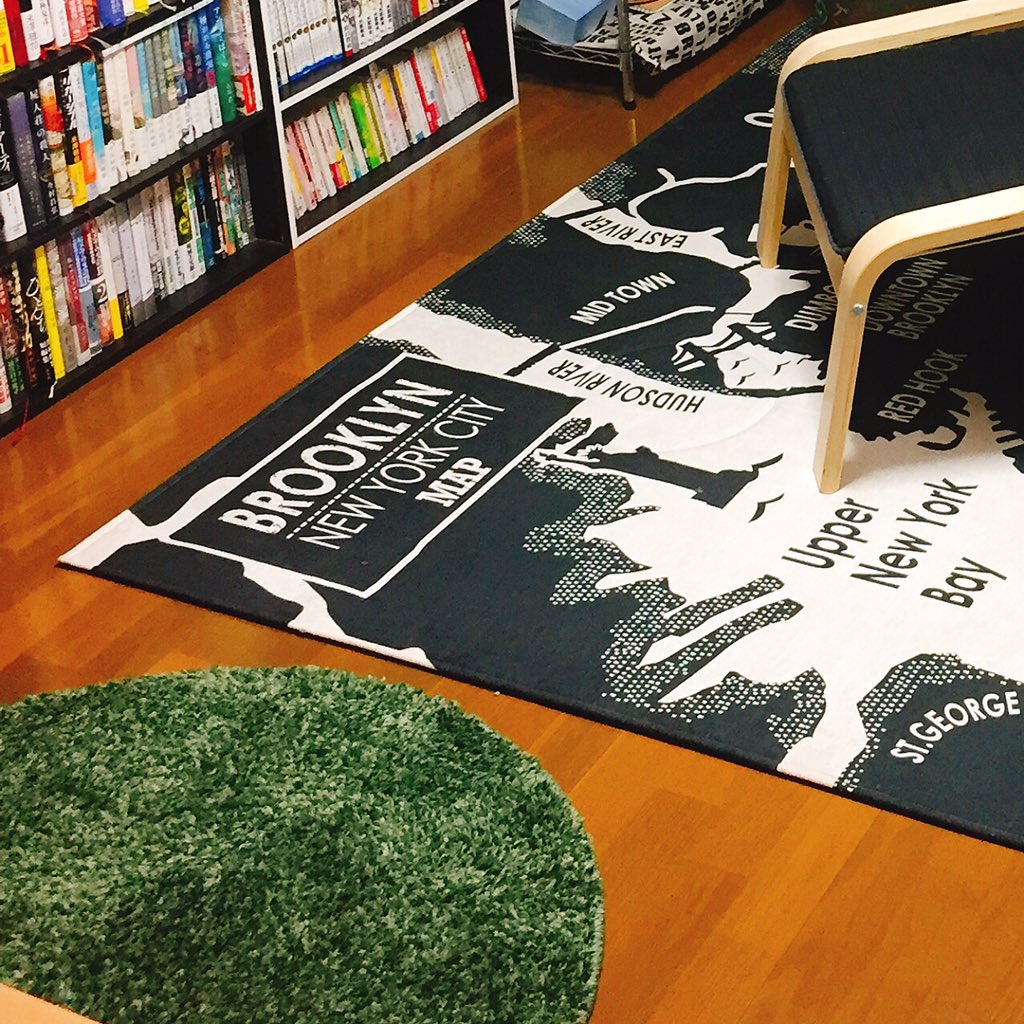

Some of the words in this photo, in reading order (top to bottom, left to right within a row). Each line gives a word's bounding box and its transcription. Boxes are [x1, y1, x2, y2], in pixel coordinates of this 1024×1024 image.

[584, 216, 638, 242] RIVER
[639, 226, 687, 248] EAST
[569, 300, 617, 326] MID
[604, 271, 676, 304] TOWN
[887, 273, 973, 340] BROOKLYN
[547, 358, 607, 390] RIVER
[601, 375, 705, 414] HUDSON
[877, 394, 927, 423] RED
[904, 348, 968, 394] HOOK
[219, 377, 454, 535] BROOKLYN
[298, 494, 386, 550] NEW
[360, 438, 459, 494] YORK
[433, 396, 506, 441] CITY
[415, 456, 494, 507] MAP
[782, 497, 880, 569] Upper
[850, 531, 932, 589] New
[896, 477, 978, 528] York
[921, 556, 1008, 608] Bay
